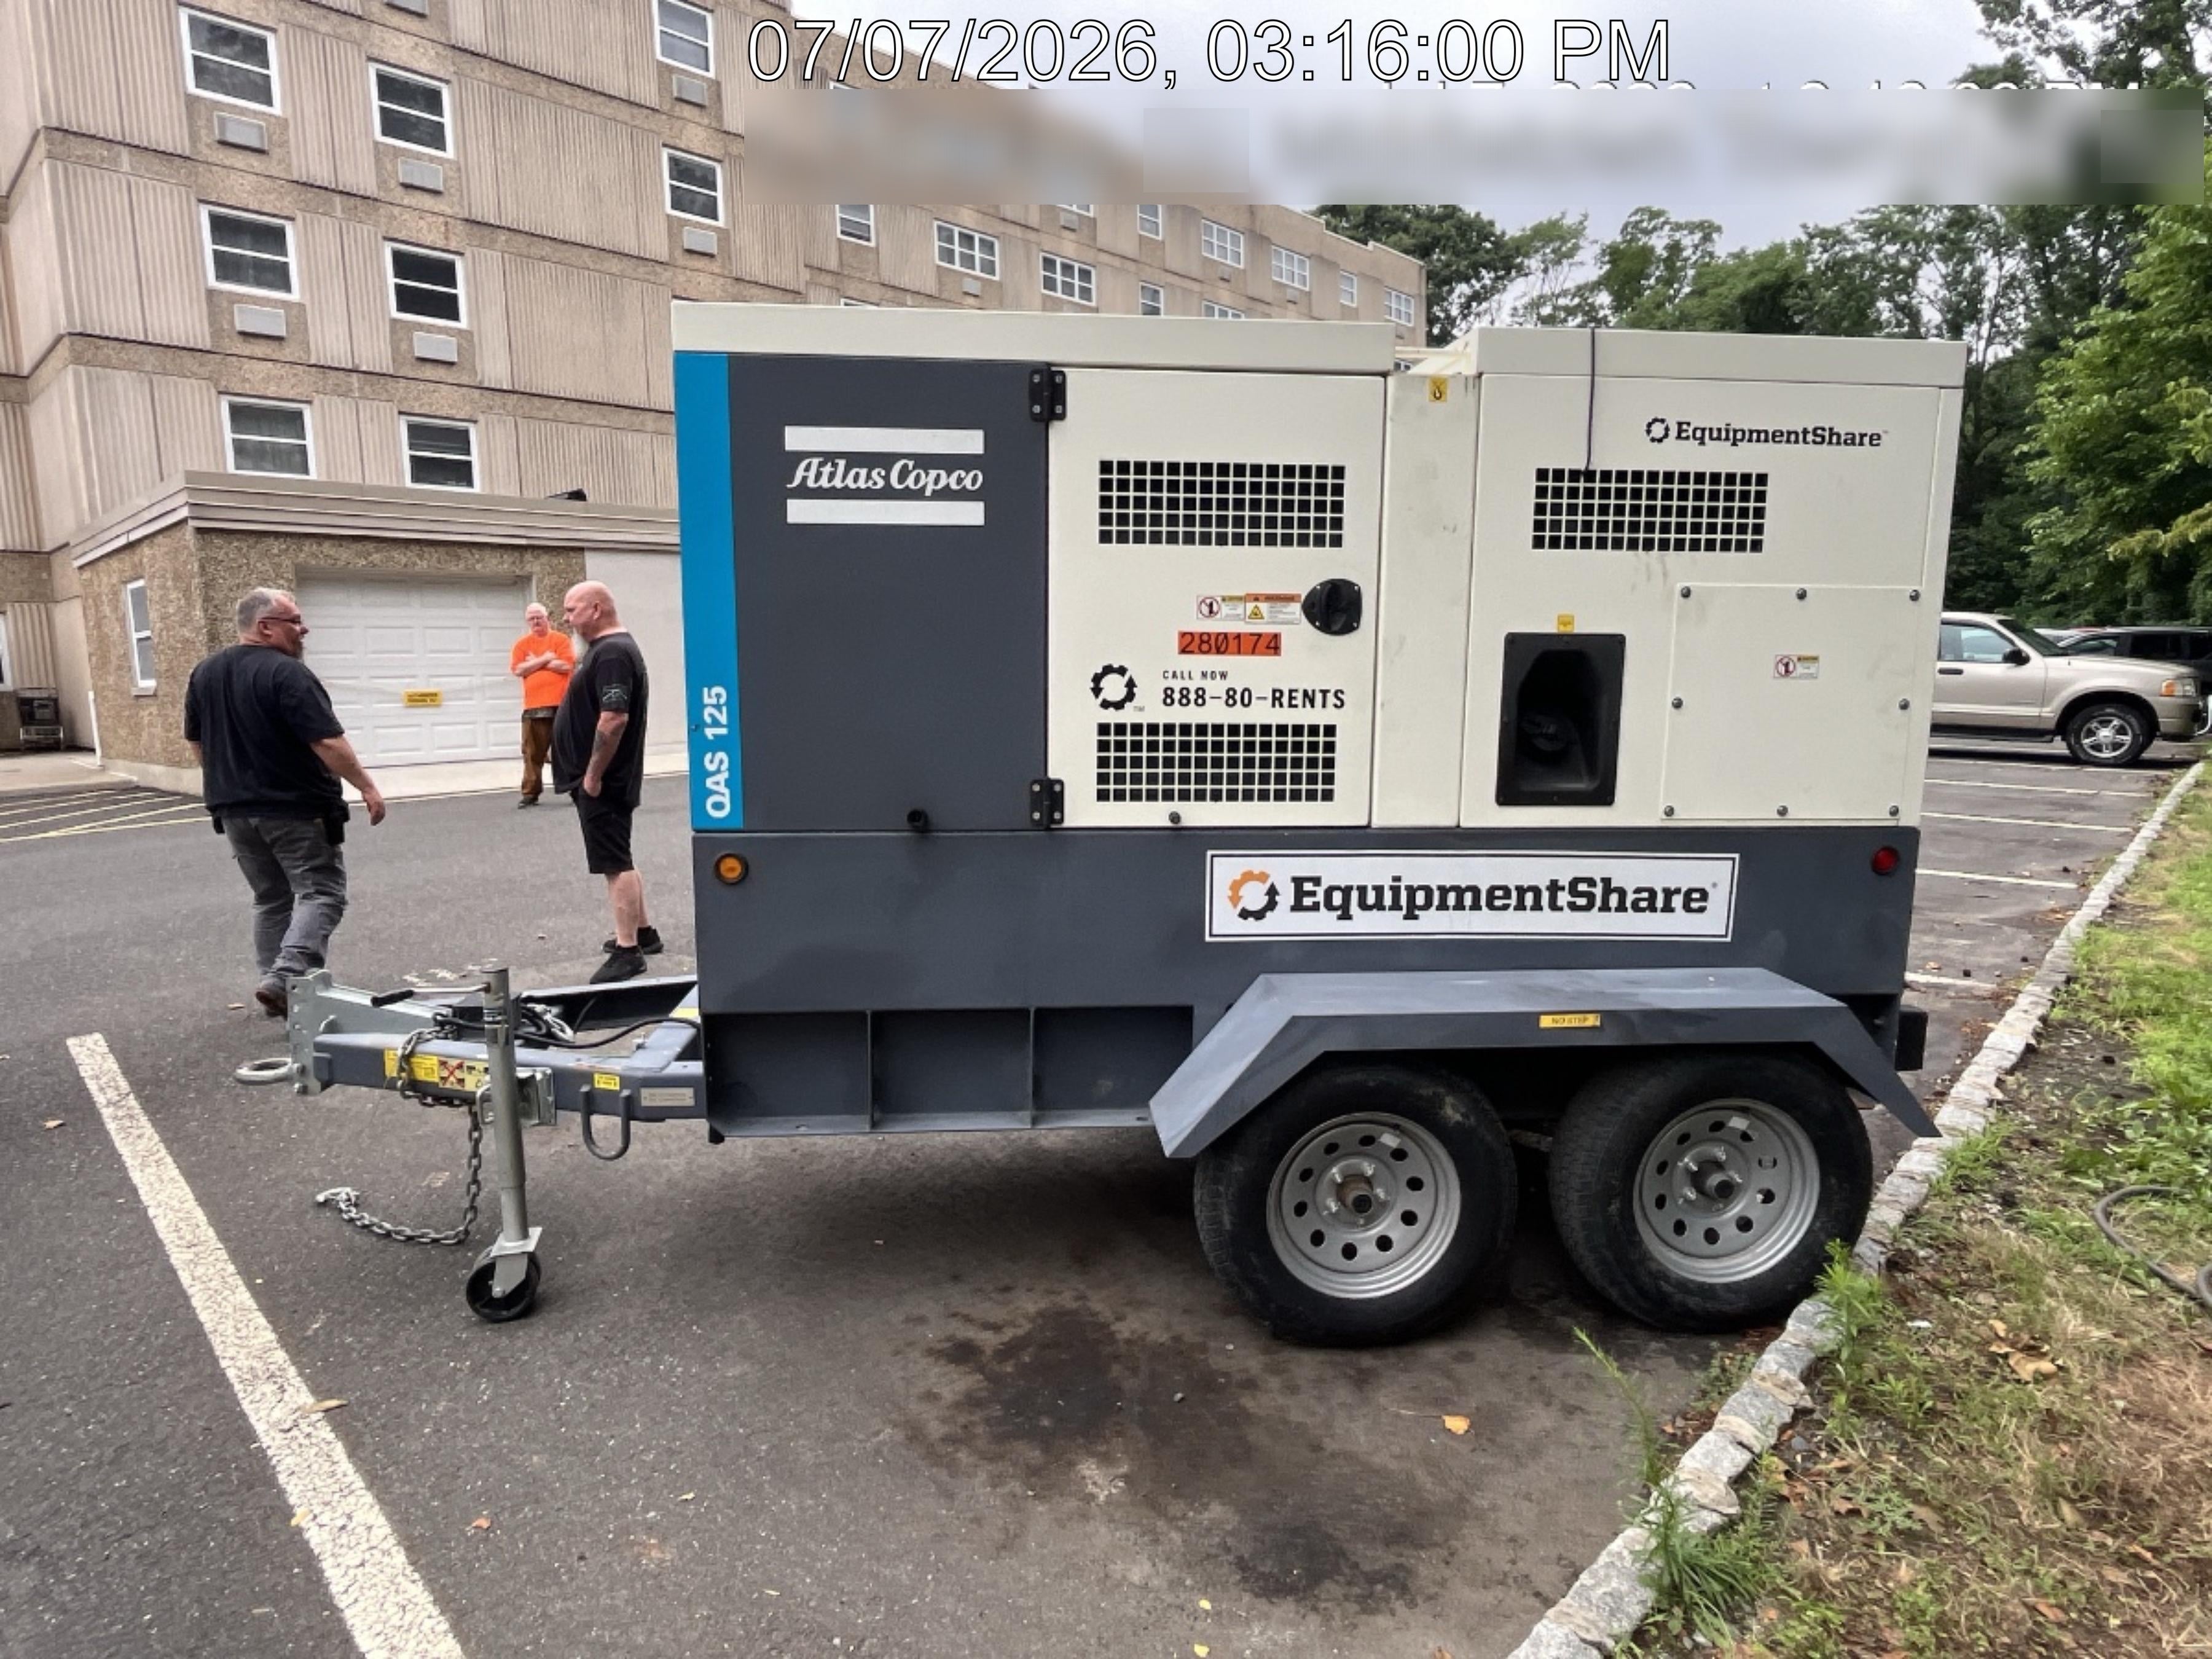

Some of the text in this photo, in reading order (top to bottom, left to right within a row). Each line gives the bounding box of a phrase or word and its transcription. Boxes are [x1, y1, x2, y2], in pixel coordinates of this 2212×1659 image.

[1675, 420, 1881, 447] EquipmentShare
[786, 457, 983, 497] Atlas Copco
[1180, 632, 1280, 655] 280174
[1162, 670, 1229, 681] CALL NOW
[1162, 686, 1346, 709] 888-80-RENTS
[702, 685, 731, 819] QAS 125
[1289, 874, 1710, 921] EquipmentShare
